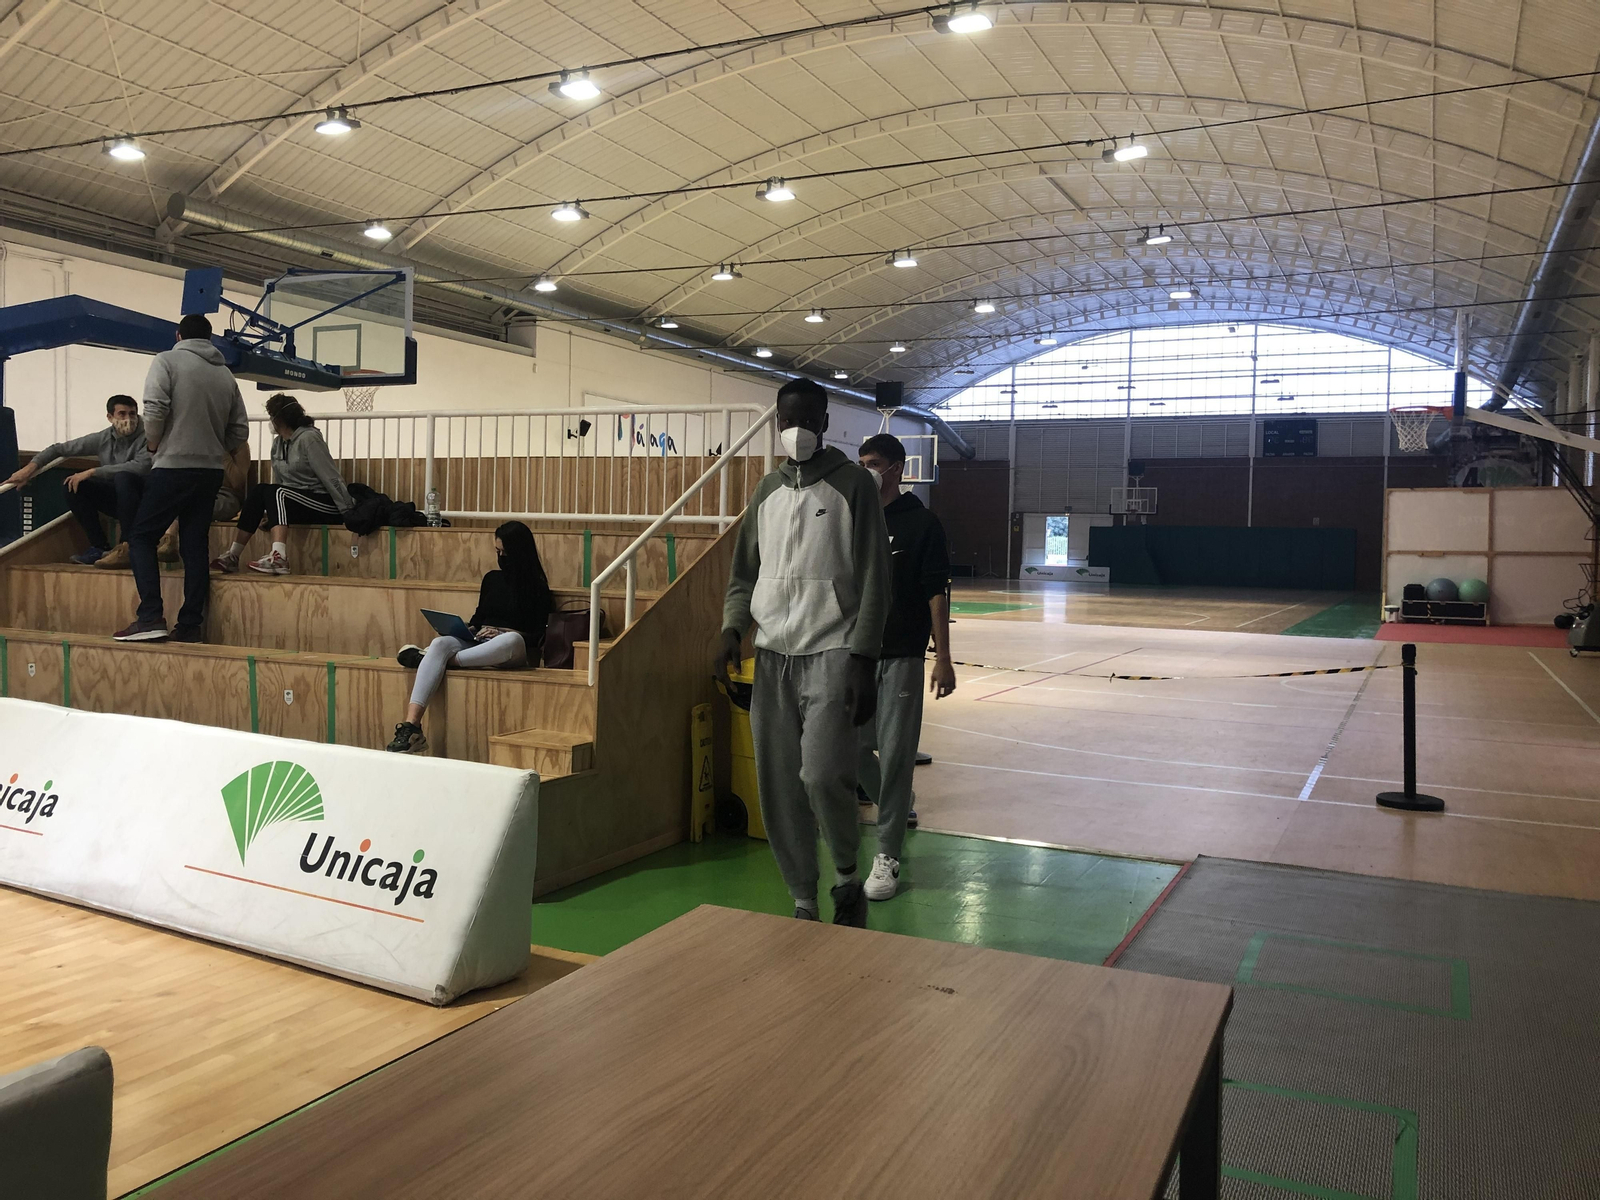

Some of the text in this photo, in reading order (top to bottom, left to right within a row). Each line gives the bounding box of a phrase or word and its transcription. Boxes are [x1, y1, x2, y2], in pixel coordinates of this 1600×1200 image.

[284, 369, 306, 379] MONDO
[617, 413, 678, 457] Máaga
[0, 773, 59, 825] icaja
[299, 832, 438, 906] Unicaja
